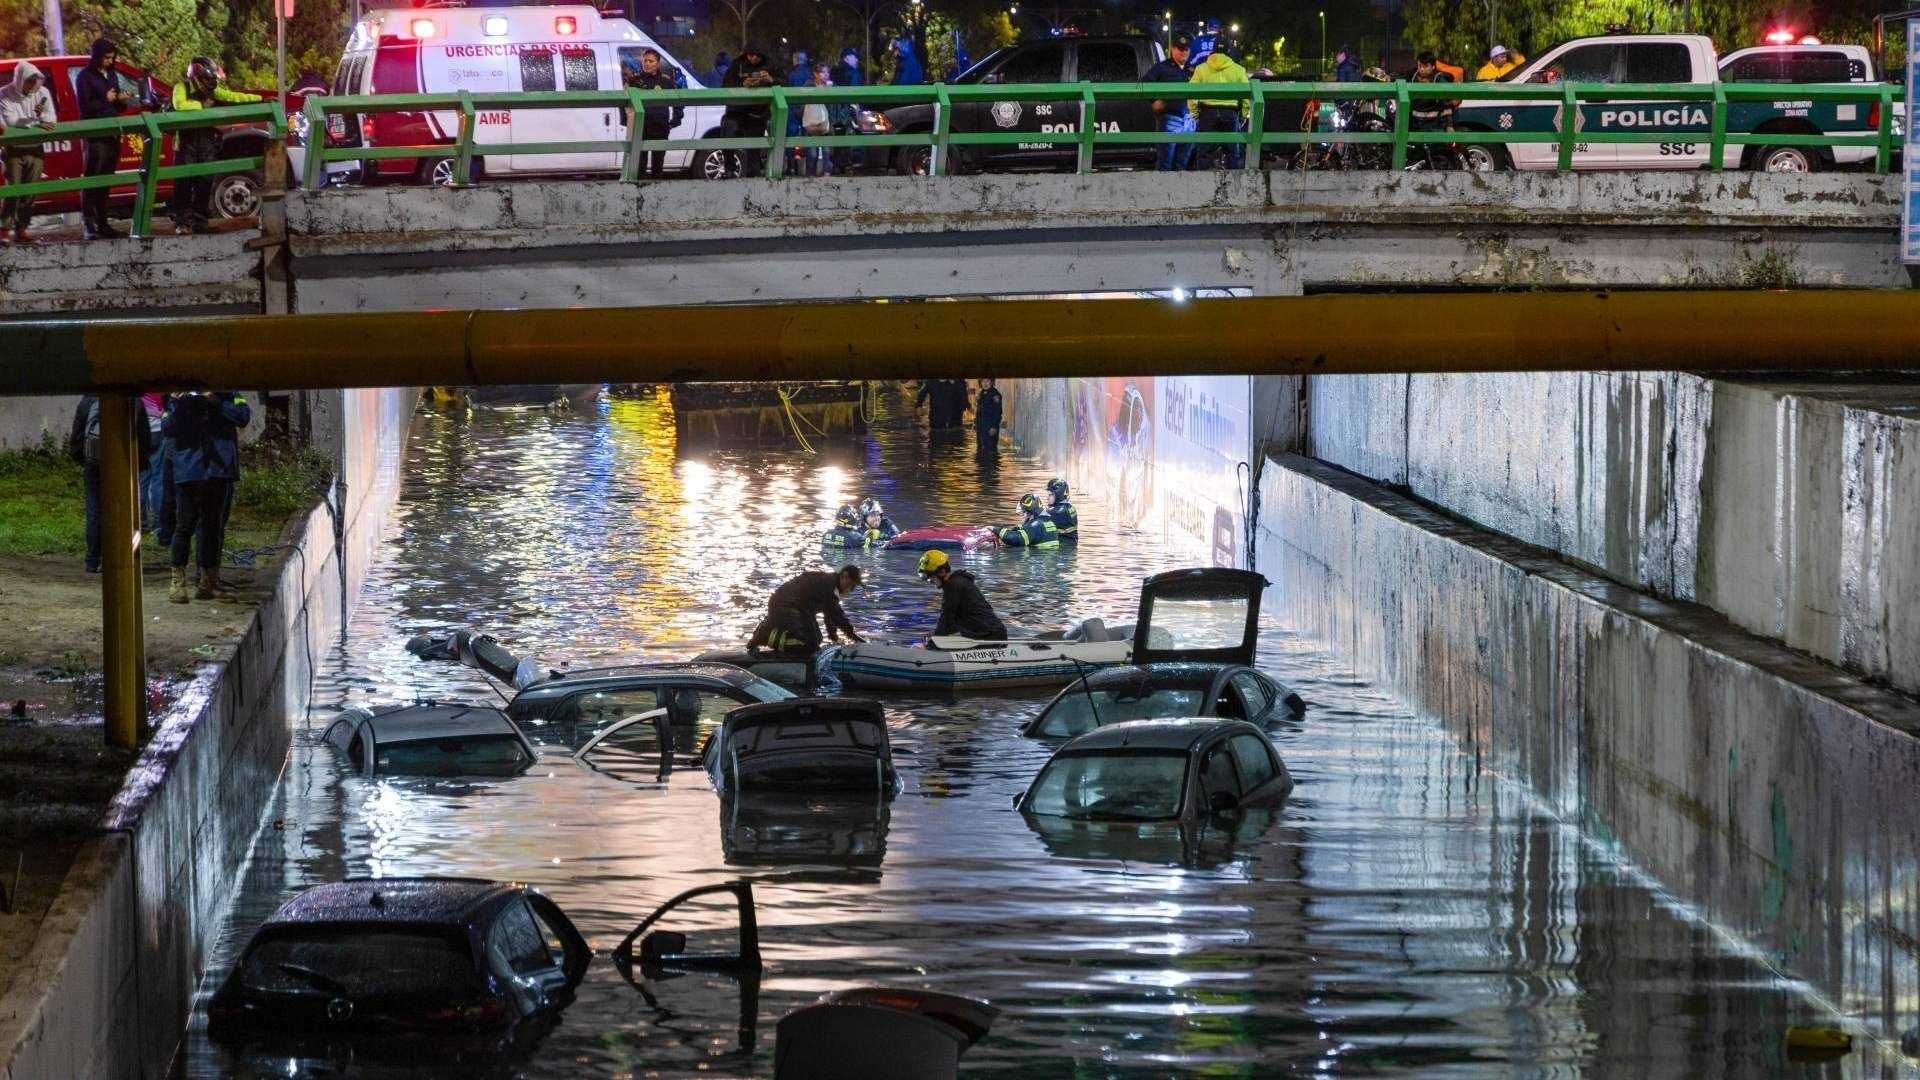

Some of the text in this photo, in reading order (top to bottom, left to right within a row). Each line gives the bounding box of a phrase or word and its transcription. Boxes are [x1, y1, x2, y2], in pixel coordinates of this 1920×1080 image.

[445, 43, 527, 57] URGENCIAS
[1035, 105, 1053, 115] SSC
[1601, 106, 1709, 127] POLICÍA
[479, 112, 511, 125] AMB
[1659, 142, 1696, 155] SSC
[955, 649, 1019, 661] MARINER 4
